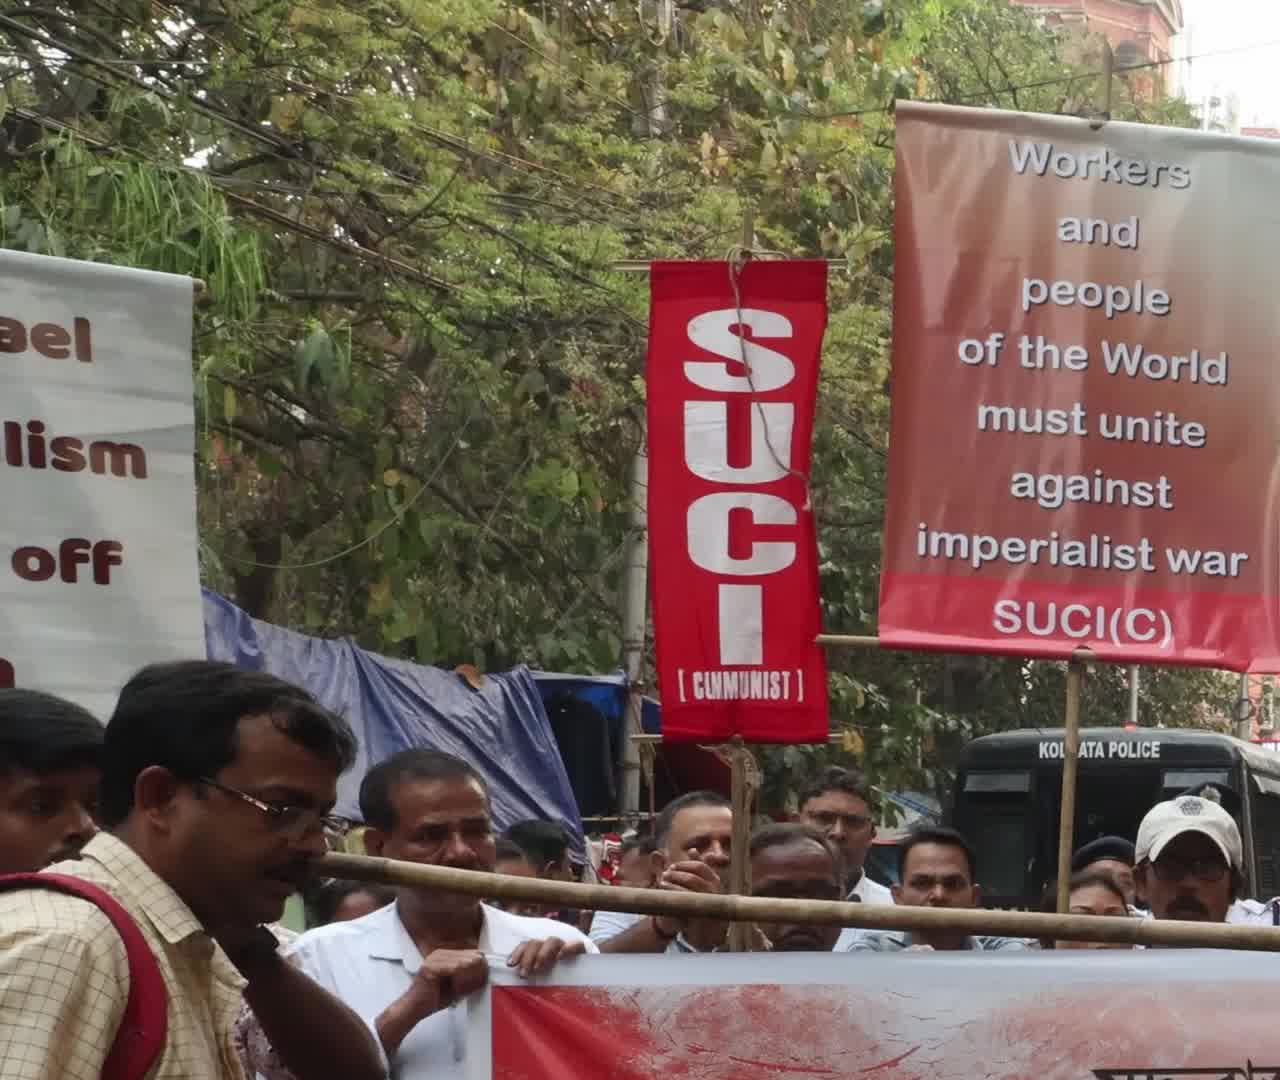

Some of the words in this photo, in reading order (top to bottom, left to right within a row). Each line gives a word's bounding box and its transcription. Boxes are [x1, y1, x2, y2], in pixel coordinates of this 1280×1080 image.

[1007, 139, 1192, 190] Workers
[1057, 214, 1140, 250] and
[1022, 274, 1172, 319] people
[0, 316, 94, 362] ael
[958, 332, 1006, 367] of
[1018, 334, 1089, 372] the
[1101, 340, 1229, 387] World
[977, 398, 1087, 437] must
[1100, 409, 1207, 448] unite
[4, 419, 148, 479] lism
[683, 307, 798, 666] SUCI
[1010, 468, 1174, 512] against
[12, 538, 123, 586] off
[916, 523, 1155, 574] imperialist
[1166, 543, 1248, 578] war
[992, 600, 1175, 649] SUCI(C)
[1039, 741, 1105, 759] KOLATA
[1108, 741, 1161, 759] POLICE
